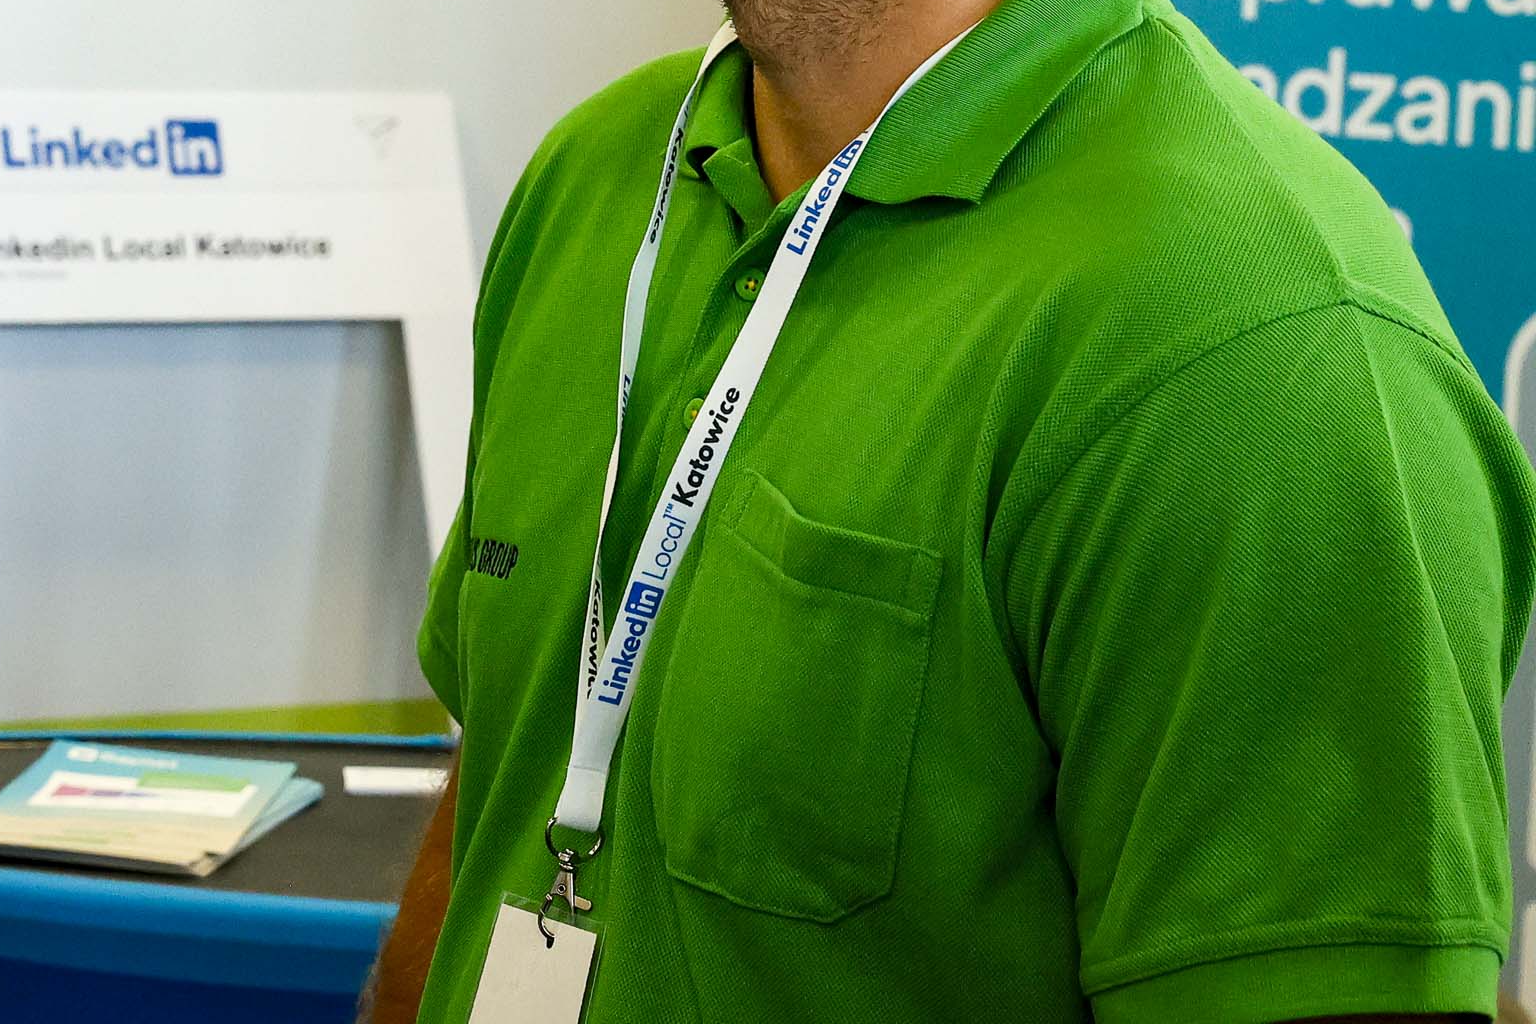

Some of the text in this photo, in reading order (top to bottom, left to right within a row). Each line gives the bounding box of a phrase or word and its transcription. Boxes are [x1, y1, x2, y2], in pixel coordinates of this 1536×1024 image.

[103, 233, 186, 262] Local
[195, 233, 332, 261] Katowice
[672, 387, 740, 507] Katowice
[477, 539, 519, 580] GROUP
